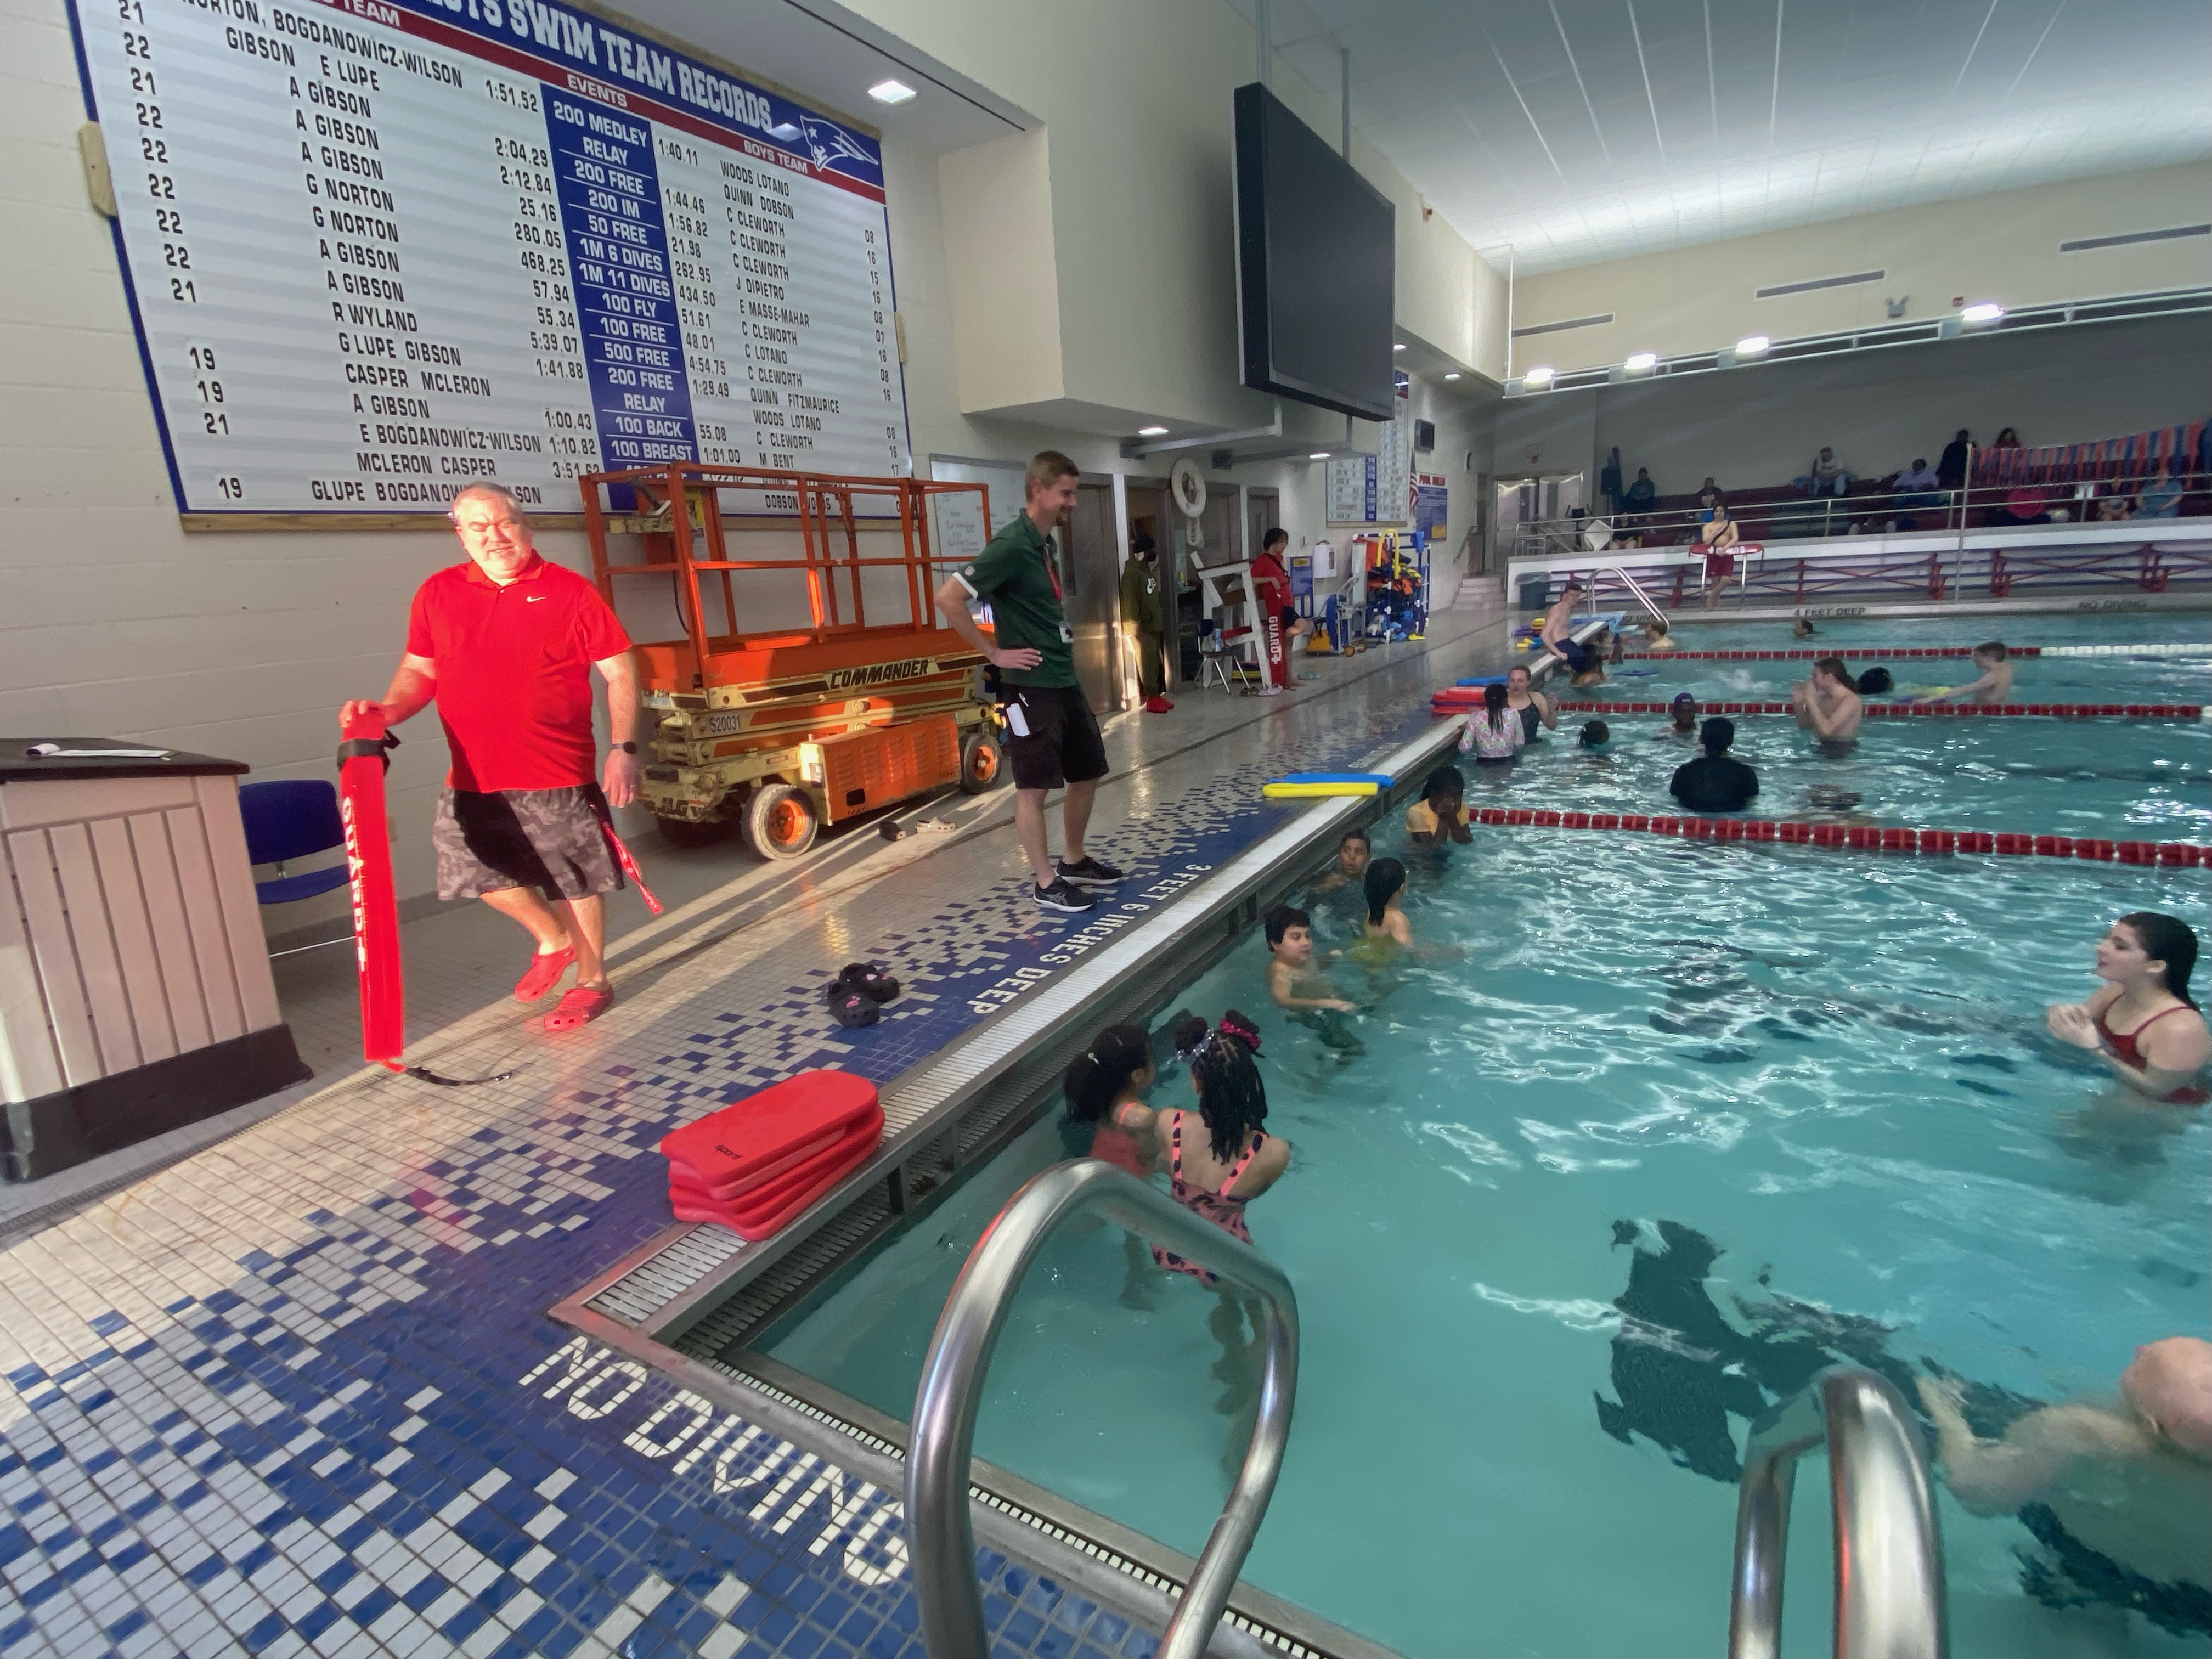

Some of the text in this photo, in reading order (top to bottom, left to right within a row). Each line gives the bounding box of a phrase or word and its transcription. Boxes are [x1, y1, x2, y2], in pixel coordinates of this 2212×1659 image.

[118, 0, 145, 25] 21
[342, 0, 401, 27] TEAM
[124, 32, 151, 60] 22
[226, 27, 380, 92] GIBSON E LUPE
[273, 9, 463, 88] BOGDANOWICZ-WILSON
[507, 0, 597, 65] SWIM
[600, 27, 675, 95] TEAM
[677, 60, 772, 134] RECORDS
[131, 67, 156, 95] 21
[567, 74, 627, 108] EVENTS
[290, 76, 371, 119] A GIBSON
[486, 79, 538, 113] 1:51.52
[136, 103, 163, 129] 22
[296, 109, 380, 150] A GIBSON
[553, 100, 647, 148] 200 MEDLEY
[142, 137, 168, 165] 22
[302, 142, 384, 181] A GIBSON
[495, 137, 548, 167] 2:04.29
[583, 136, 628, 166] RELAY
[658, 138, 698, 166] 1:40.11
[744, 140, 808, 174] BOYS TEAM
[148, 174, 176, 200] 22
[500, 165, 551, 195] 2:12.84
[575, 159, 645, 196] 200 FREE
[720, 160, 789, 197] WOODS LOTANO
[306, 173, 395, 212] G NORTON
[588, 189, 640, 219] 200 IM
[665, 188, 706, 215] 1:44.46
[724, 184, 794, 220] QUINN DOBSON
[157, 209, 183, 235] 22
[520, 197, 557, 222] 25.16
[727, 207, 785, 238] C CLEWORTH
[313, 206, 399, 242] G NORTON
[515, 222, 562, 249] 280.05
[588, 215, 647, 245] 50 FREE
[669, 212, 708, 238] 1:56.82
[164, 243, 191, 270] 22
[319, 239, 400, 273] A GIBSON
[579, 237, 663, 272] 1M 6 DIVES
[672, 236, 701, 258] 21.98
[730, 230, 786, 259] C CLEWORTH
[522, 251, 565, 276] 468.25
[675, 261, 712, 284] 262.95
[733, 252, 789, 281] C CLEWORTH
[171, 278, 197, 303] 21
[327, 270, 405, 302] A GIBSON
[533, 279, 569, 303] 57.94
[579, 262, 671, 297] 1M 11 DIVES
[736, 276, 785, 301] J DIPIETRO
[602, 292, 657, 318] 100 FLY
[679, 285, 716, 307] 434.50
[332, 302, 417, 332] R WYLAND
[537, 306, 575, 330] 55.34
[681, 308, 711, 329] 51.61
[740, 299, 810, 328] E MASSE-MAHAR
[530, 331, 577, 354] 5:39.07
[600, 317, 667, 343] 100 FREE
[686, 332, 715, 352] 48.01
[742, 320, 798, 346] C CLEWORTH
[189, 347, 216, 370] 19
[338, 332, 462, 366] G LUPE GIBSON
[604, 342, 670, 368] 500 FREE
[745, 343, 788, 365] C LOTANO
[536, 358, 583, 379] 1:41.88
[608, 367, 674, 391] 200 FREE
[689, 356, 726, 376] 4:54.75
[747, 366, 803, 387] C CLEWORTH
[198, 380, 224, 403] 19
[345, 363, 492, 397] CASPER MCLERON
[692, 379, 729, 398] 1:29.49
[353, 393, 430, 419] A GIBSON
[623, 393, 665, 413] RELAY
[751, 387, 840, 414] QUINN FITZMAURICE
[204, 412, 229, 435] 21
[545, 410, 592, 431] 1:00.43
[615, 416, 683, 438] 100 BACK
[699, 424, 727, 442] 55.08
[753, 409, 821, 431] WOODS LOTANO
[359, 423, 541, 453] E BOGDANOWICZ-WILSON
[549, 437, 596, 455] 1:10.82
[611, 440, 692, 461] 100 BREAST
[757, 431, 814, 450] C CLEWORTH
[356, 452, 496, 476] MCLERON CASPER
[703, 447, 741, 464] 1:01.00
[759, 452, 794, 469] M BENT
[219, 477, 242, 499] 19
[311, 480, 365, 501] GLUPE
[1836, 607, 1865, 616] DEEP
[1269, 616, 1280, 653] GUARD
[831, 660, 929, 690] COMMANDER
[342, 795, 363, 932] GUARD
[966, 863, 1212, 1015] 3 FEET 6 INCHES DEEP
[518, 1335, 910, 1586] NO DIVING
